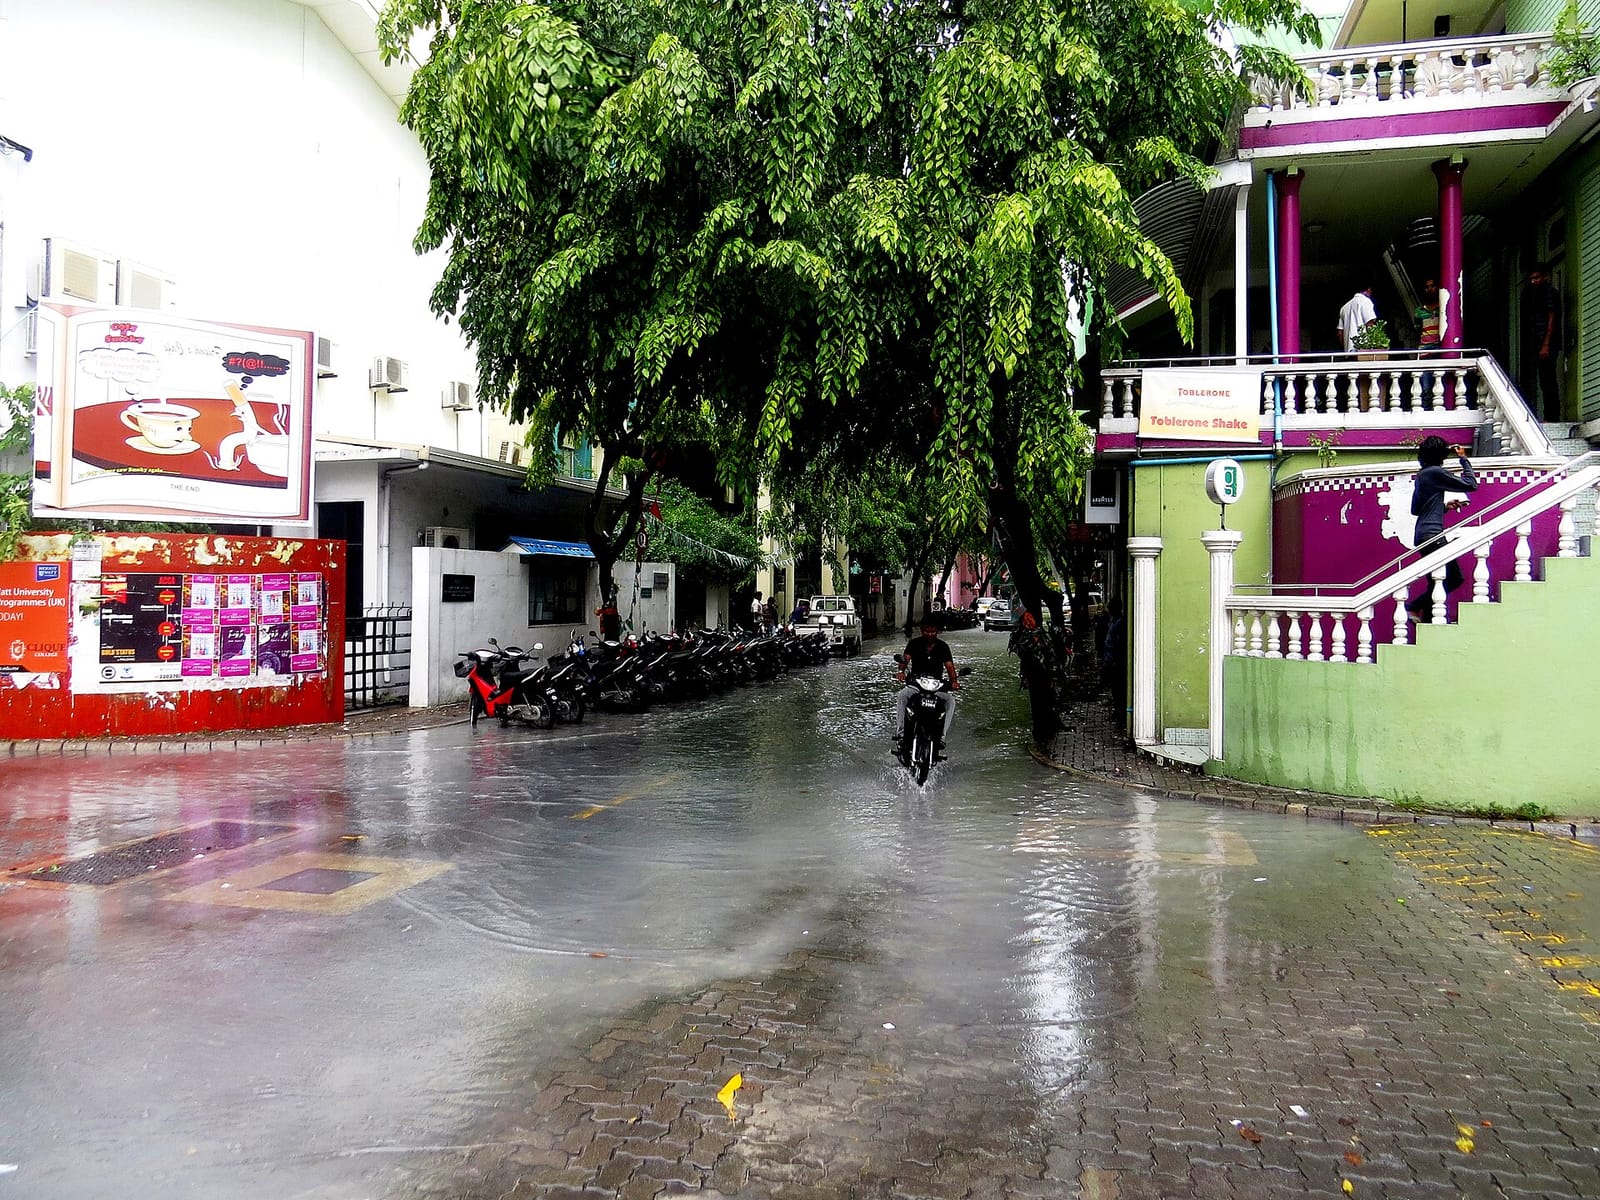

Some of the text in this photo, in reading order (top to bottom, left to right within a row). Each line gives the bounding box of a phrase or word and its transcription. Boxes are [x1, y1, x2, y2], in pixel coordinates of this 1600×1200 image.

[1178, 388, 1231, 397] TOBLERONE
[1150, 415, 1248, 430] Toblerone Shake
[170, 483, 200, 493] THE END
[13, 587, 54, 598] University
[48, 598, 66, 607] (UK)
